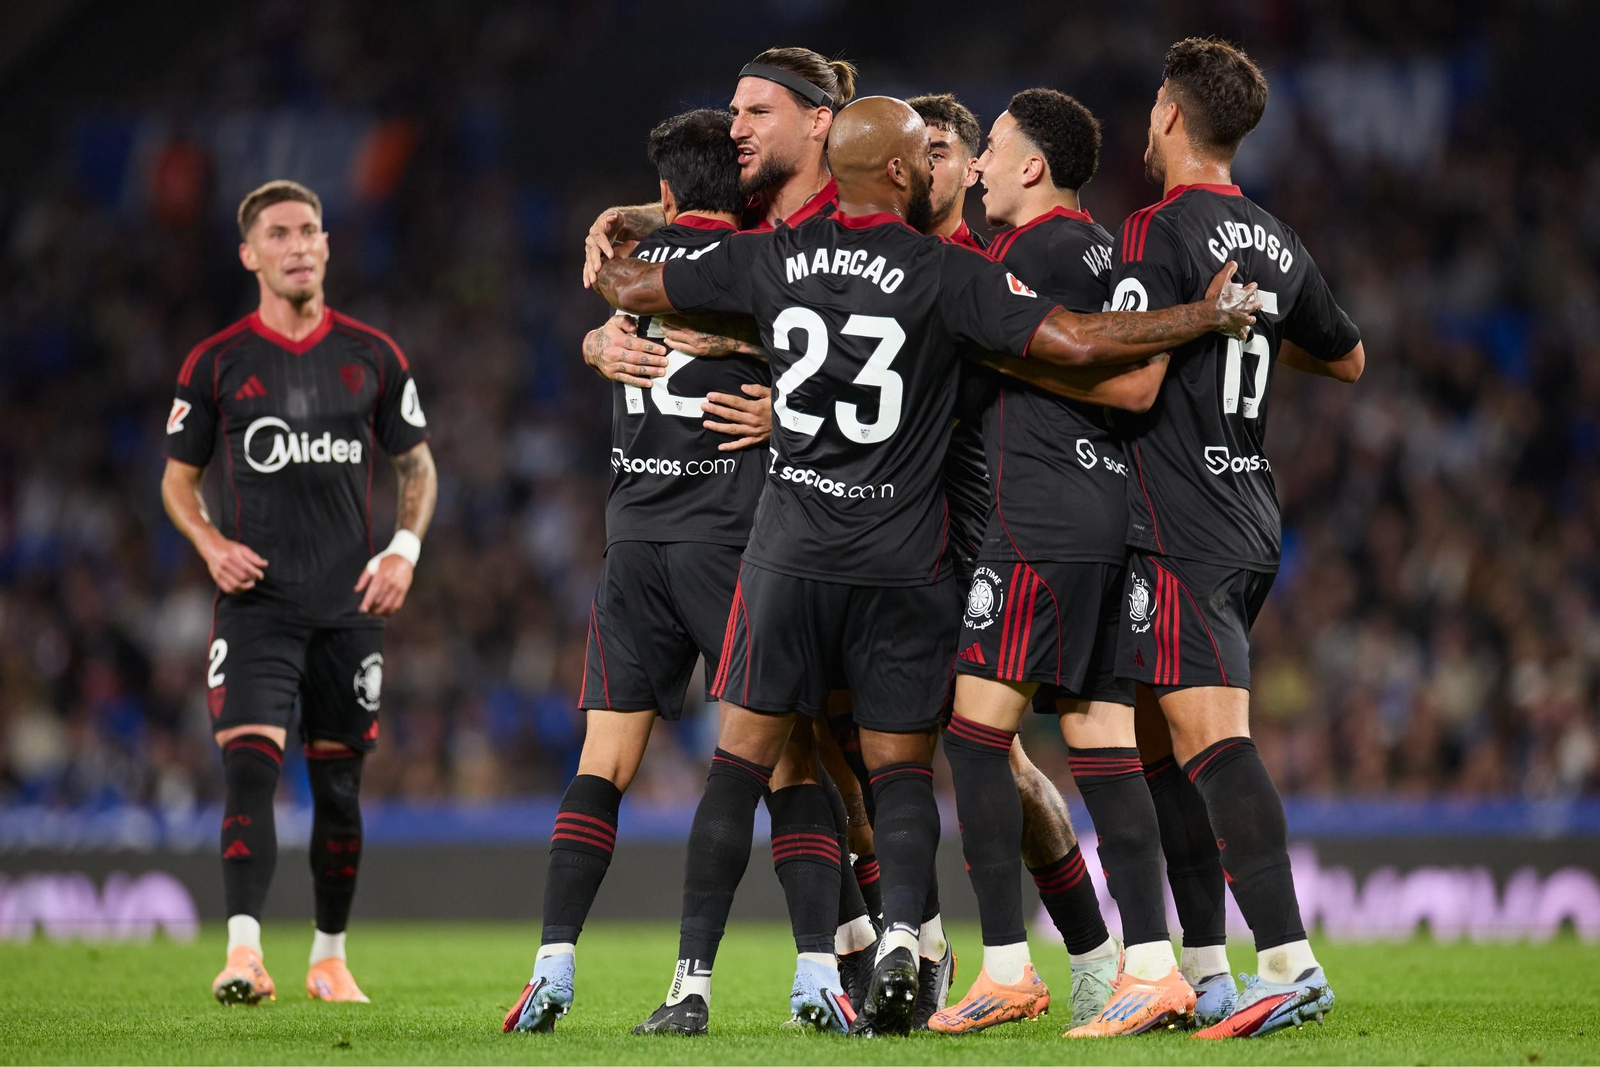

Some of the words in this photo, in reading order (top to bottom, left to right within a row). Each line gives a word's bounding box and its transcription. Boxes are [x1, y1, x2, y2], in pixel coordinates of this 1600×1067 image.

[785, 248, 905, 294] MARCAO
[772, 306, 907, 444] 23
[256, 425, 363, 466] Midea
[623, 457, 736, 476] socios.com
[780, 465, 895, 499] socios.com
[208, 638, 229, 690] 2
